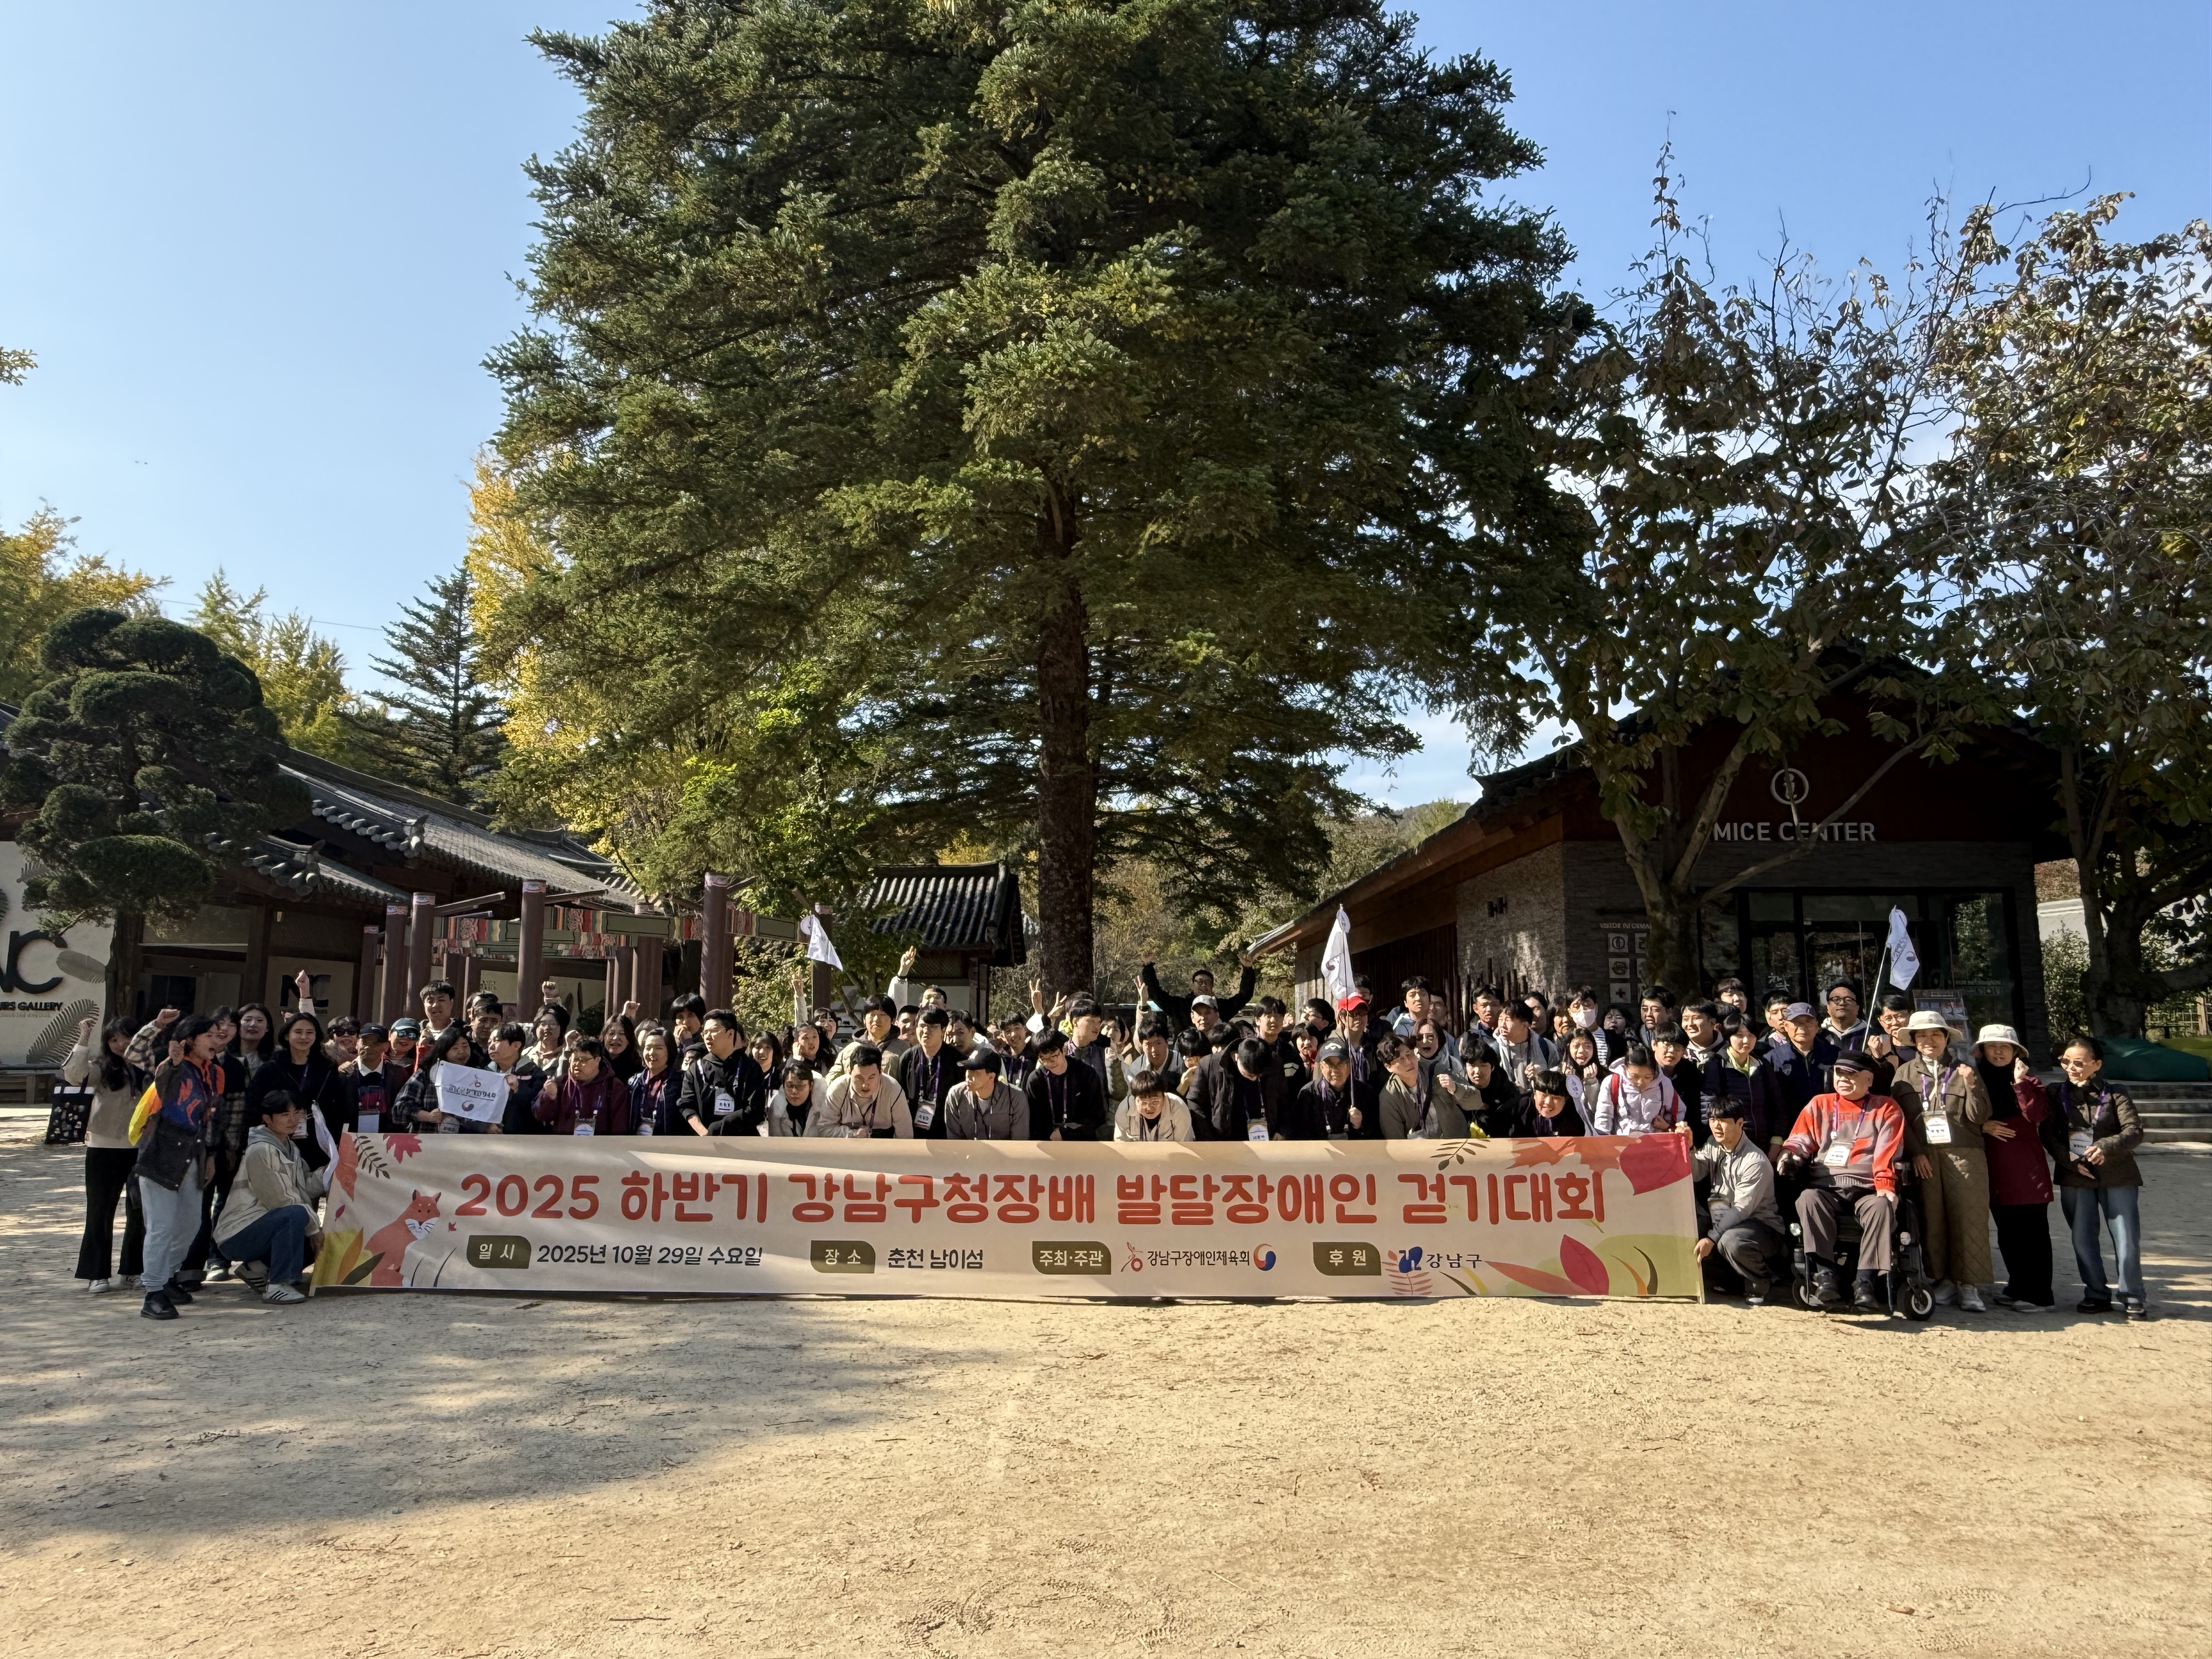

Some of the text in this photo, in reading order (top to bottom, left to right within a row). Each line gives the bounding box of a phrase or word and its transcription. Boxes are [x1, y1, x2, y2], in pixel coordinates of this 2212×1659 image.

[1714, 822, 1771, 841] MICE
[18, 1001, 63, 1011] GALLERY
[455, 1170, 1605, 1226] 2025 하반기 강남구청장배 발달장애인 걷기대회
[537, 1244, 763, 1267] 2025년 10월 29일 수요일
[888, 1248, 983, 1269] 춘천 남이섬
[1039, 1249, 1104, 1267] 주최·주관
[1147, 1250, 1250, 1266] 강남구장애인체육회
[1426, 1253, 1482, 1268] 강남구
